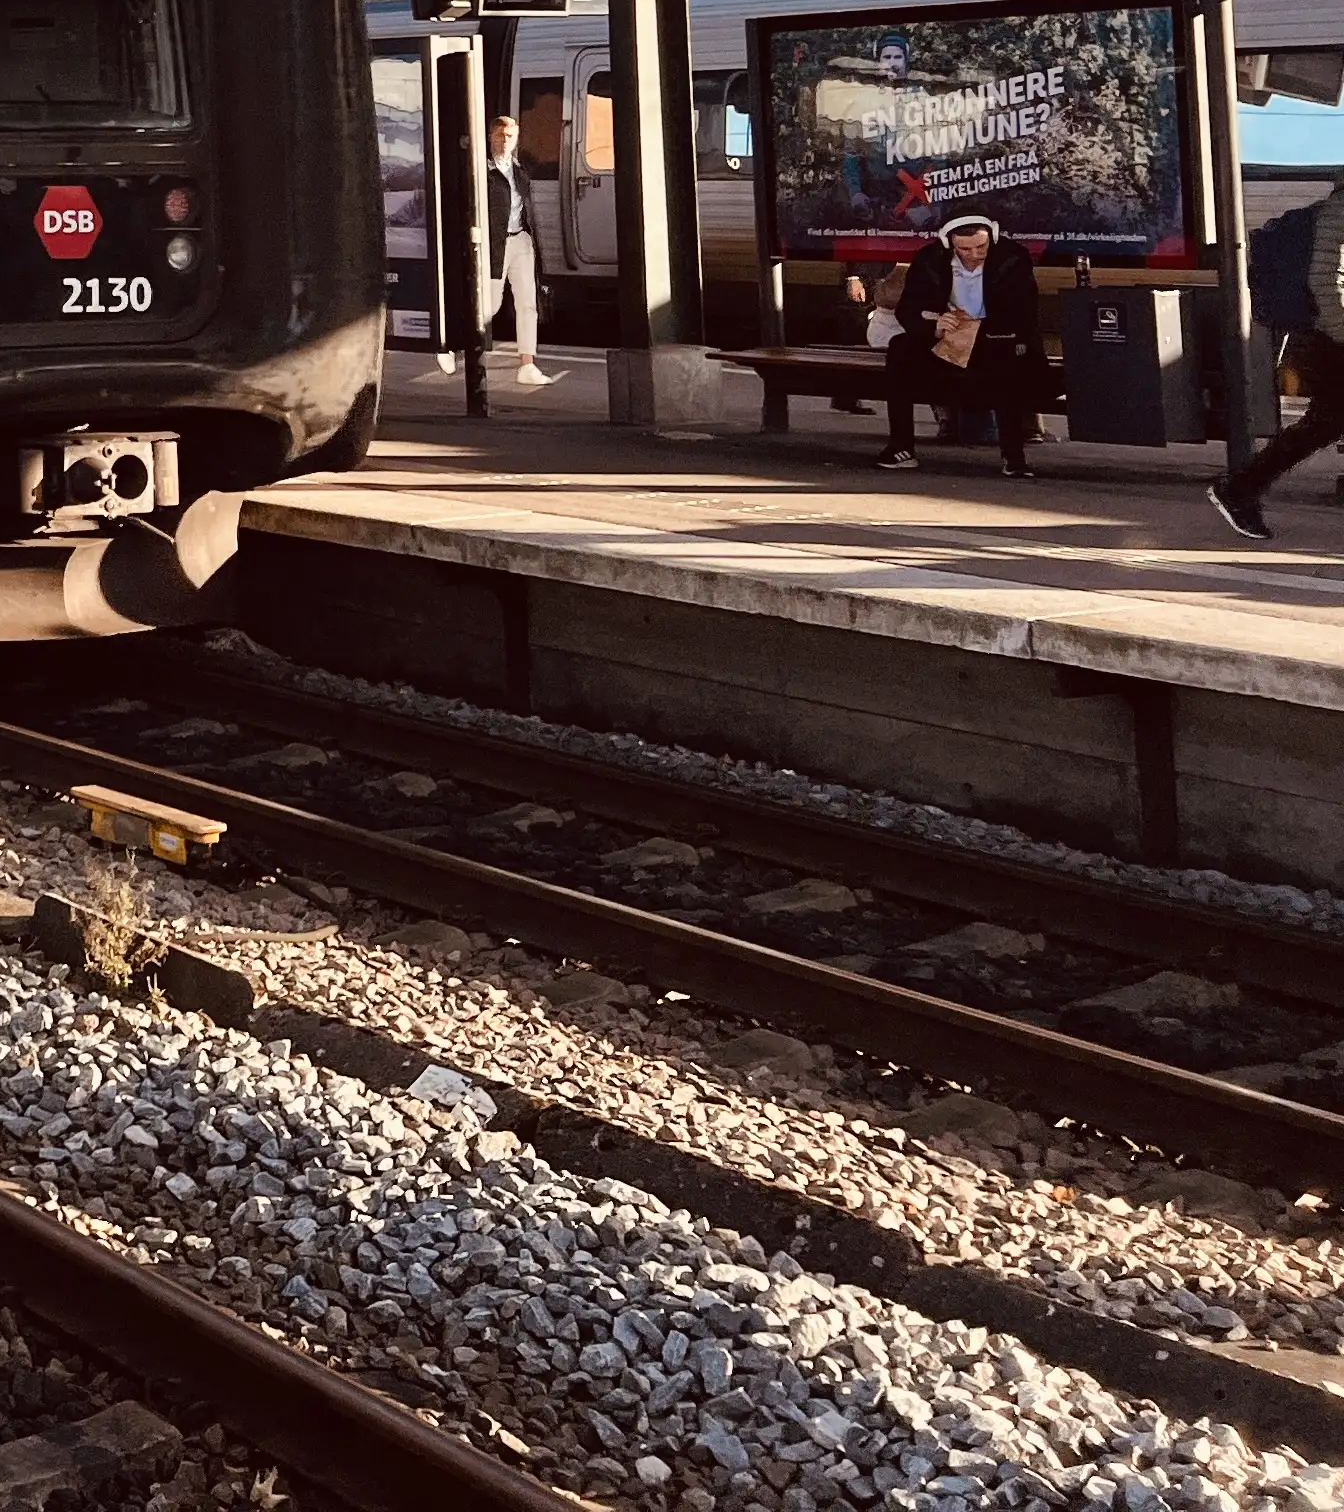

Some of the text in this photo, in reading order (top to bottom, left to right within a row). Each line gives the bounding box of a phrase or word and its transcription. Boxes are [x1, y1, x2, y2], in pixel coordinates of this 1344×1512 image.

[862, 66, 1065, 139] EN GRØNNERE
[886, 102, 1051, 165] KOMMUNE?
[923, 150, 1038, 187] STEM PÅ EN FRA
[924, 167, 1041, 204] VIRKELIGHEDEN
[43, 209, 95, 234] DSB
[62, 276, 152, 313] 2130
